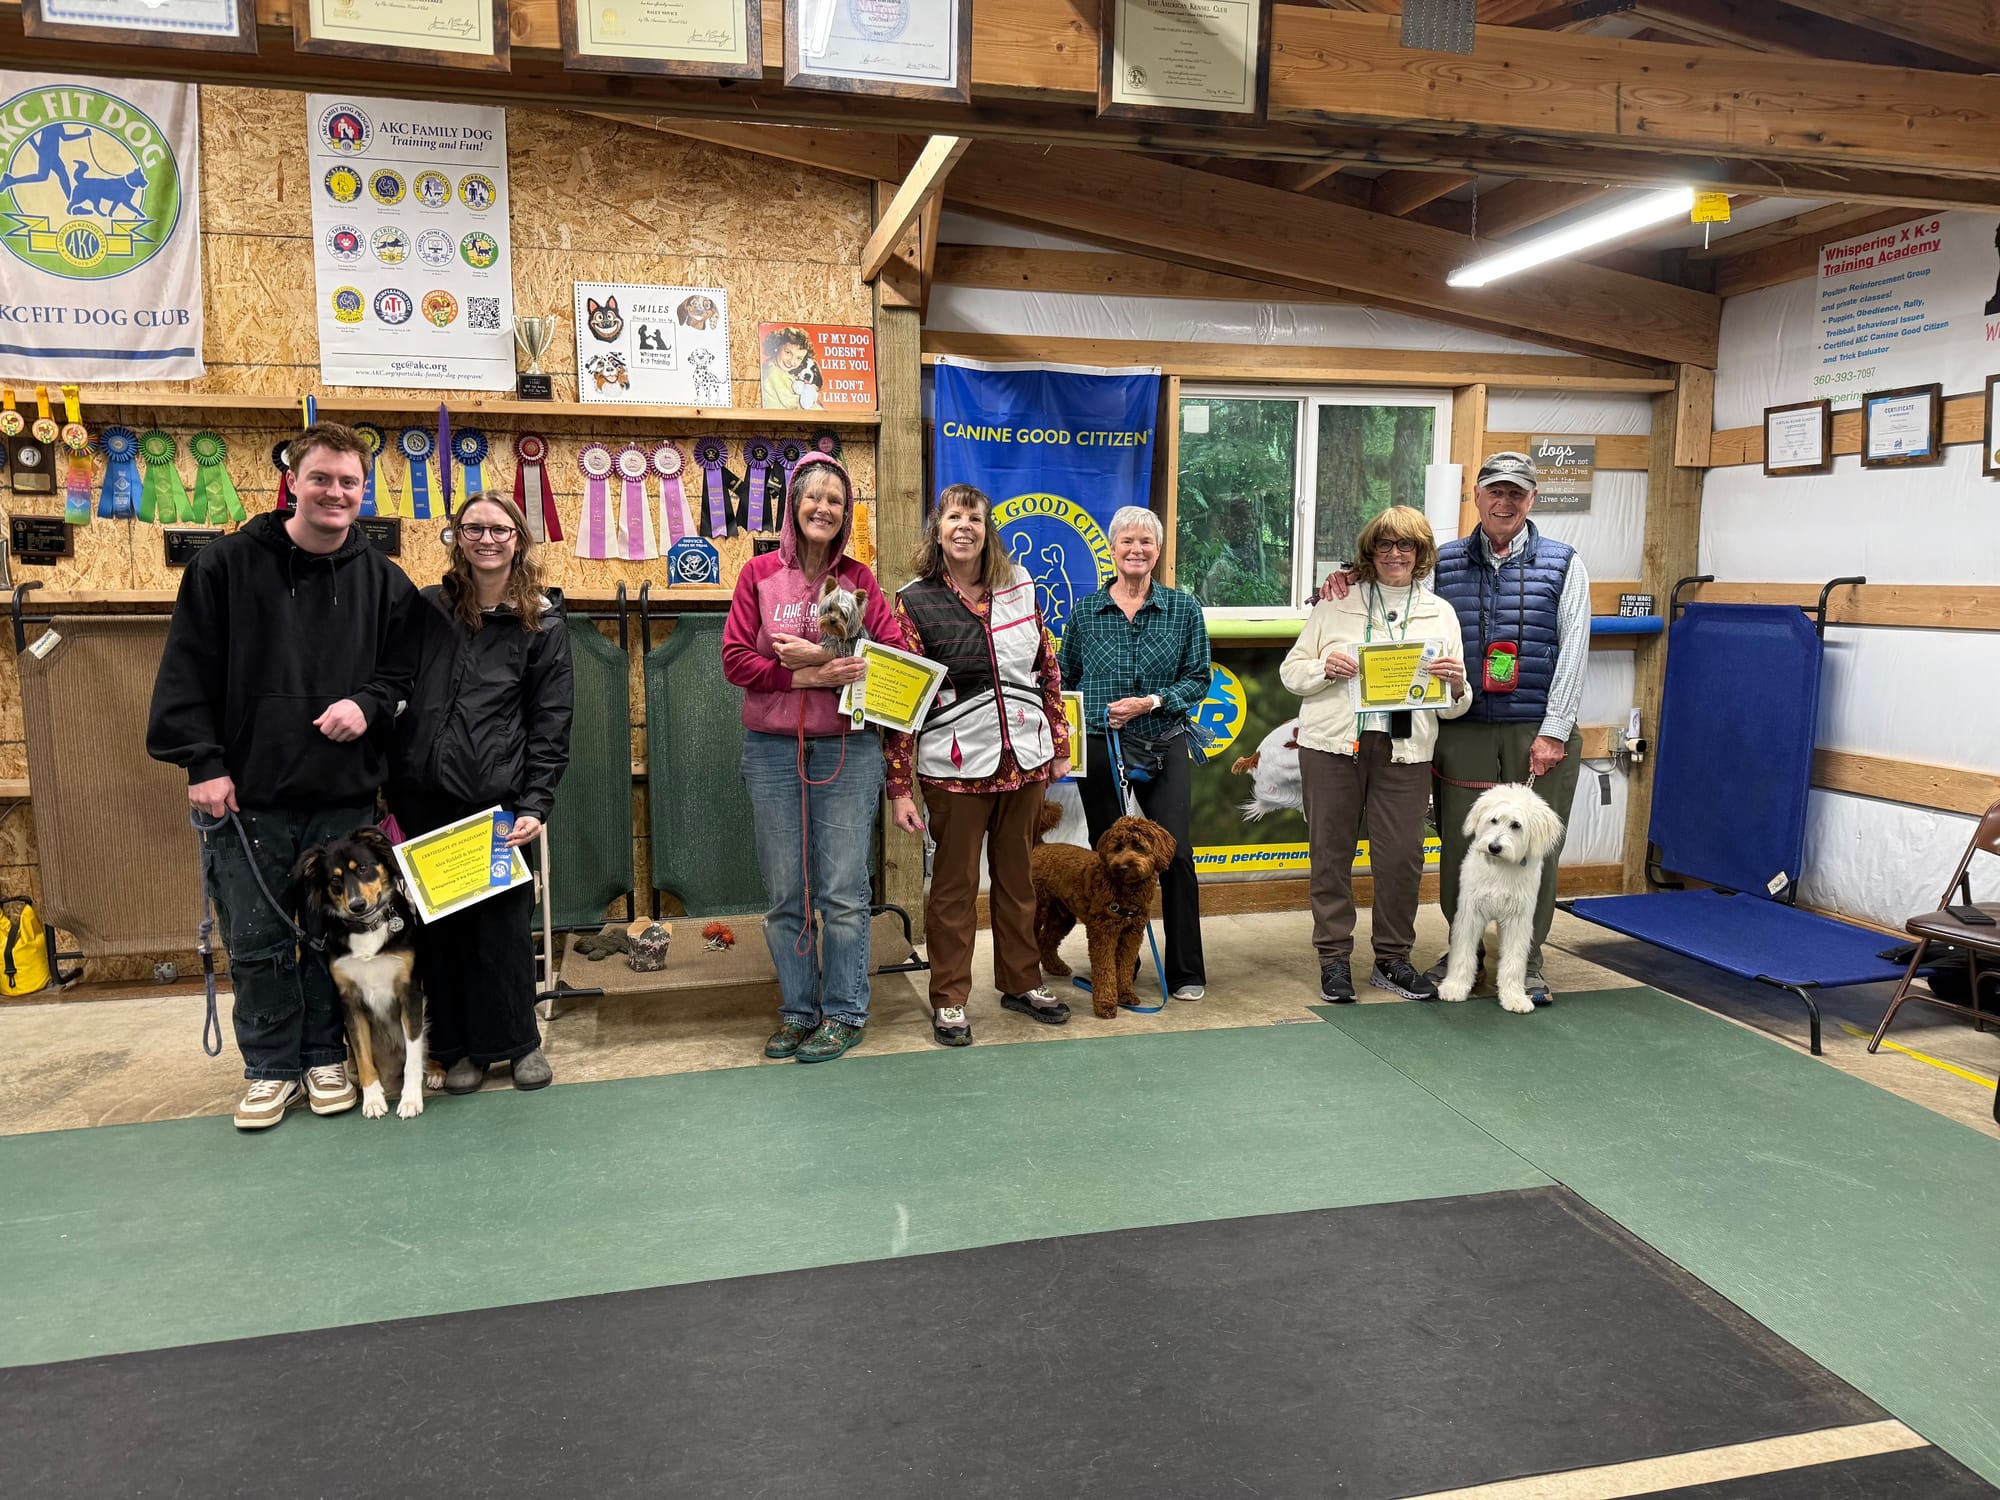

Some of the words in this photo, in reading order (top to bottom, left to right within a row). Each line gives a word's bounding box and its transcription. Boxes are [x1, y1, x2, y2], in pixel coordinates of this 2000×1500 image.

[1190, 3, 1211, 11] KENNEL
[1213, 5, 1228, 13] CLUB
[42, 92, 94, 119] FIT
[100, 102, 165, 168] DOG
[323, 107, 339, 123] FAMILY
[354, 110, 370, 139] PROGRAM
[379, 121, 408, 134] AKC
[412, 123, 458, 138] FAMILY
[463, 127, 493, 140] DOG
[391, 135, 437, 151] Training
[439, 141, 456, 150] and
[459, 140, 484, 151] Fun!
[67, 229, 99, 260] AKC
[1825, 235, 1895, 262] Whispering
[1900, 228, 1911, 242] X
[1914, 220, 1940, 239] K-9
[1823, 256, 1874, 277] Training
[1878, 239, 1942, 264] Academy
[1848, 274, 1905, 292] Reinforcement
[1906, 268, 1931, 280] Group
[385, 297, 401, 312] ATT
[632, 303, 669, 314] SMILES
[1821, 303, 1835, 312] and
[1860, 290, 1893, 303] classes!
[1856, 305, 1901, 317] Obedience,
[1903, 299, 1925, 309] Rally,
[0, 304, 28, 323] KC
[32, 306, 67, 323] FIT
[73, 308, 128, 325] DOG
[134, 309, 190, 327] CLUB
[1857, 318, 1898, 331] Behavioral
[1900, 313, 1925, 324] Issues
[818, 333, 829, 344] IF
[831, 333, 847, 345] MY
[849, 334, 870, 345] DOG
[1823, 339, 1854, 351] Certified
[1855, 335, 1869, 345] AKC
[1870, 331, 1899, 341] Canine
[1901, 326, 1921, 337] Good
[1923, 320, 1949, 332] Citizen
[824, 346, 865, 358] DOESN'T
[1823, 355, 1837, 364] and
[1839, 351, 1856, 361] Trick
[1857, 346, 1890, 358] Evaluator
[391, 360, 448, 372] cgc@akc.org
[821, 359, 847, 370] LIKE
[849, 360, 871, 372] YOU,
[1813, 366, 1876, 386] 360-393-7097
[829, 380, 834, 390] I
[835, 380, 864, 391] DON'T
[823, 392, 848, 403] LIKE
[850, 393, 873, 404] YOU.
[1884, 404, 1915, 413] CERTIFICATE
[943, 421, 1012, 443] CANINE
[1016, 428, 1071, 445] GOOD
[1538, 438, 1575, 467] dogs
[1549, 467, 1569, 475] whole
[1571, 467, 1588, 475] lives
[1547, 476, 1559, 484] but
[1561, 476, 1576, 486] they
[1005, 497, 1069, 517] GOOD
[1073, 513, 1114, 585] CITIZE
[1620, 606, 1651, 617] HEART
[1230, 849, 1309, 865] performan
